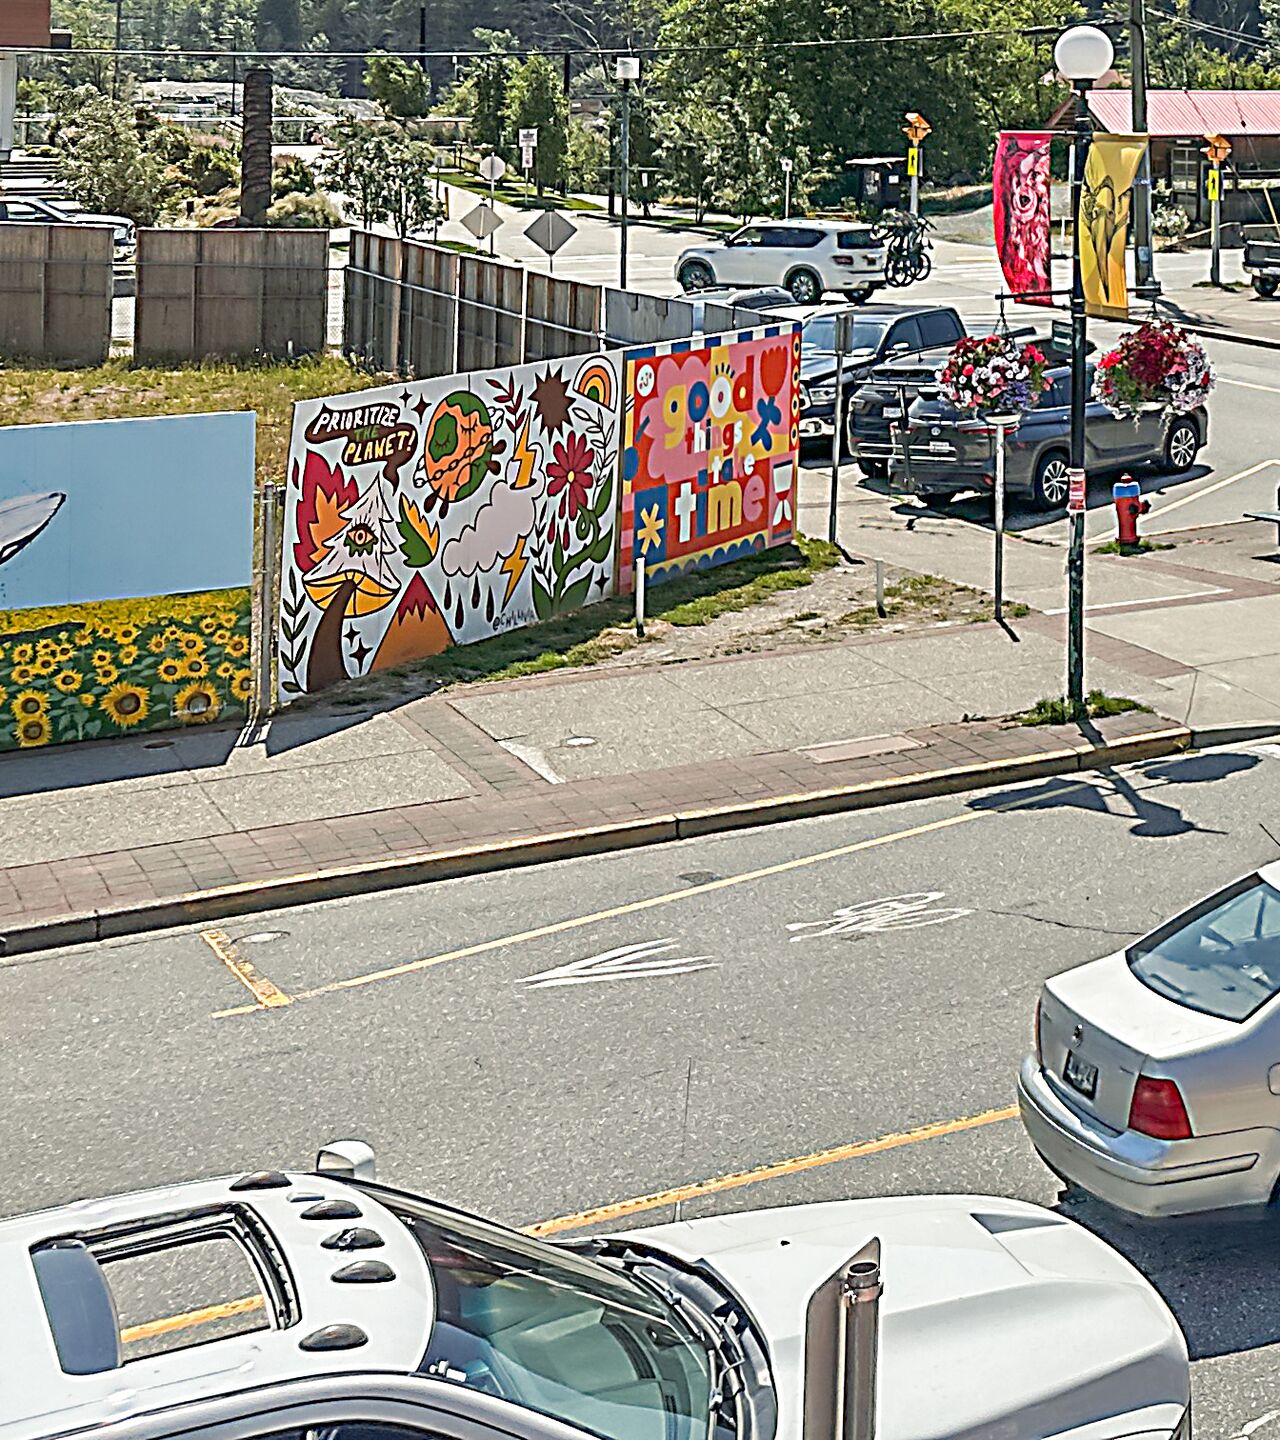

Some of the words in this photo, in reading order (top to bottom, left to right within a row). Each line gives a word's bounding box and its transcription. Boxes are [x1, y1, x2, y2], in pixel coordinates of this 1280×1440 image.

[313, 406, 399, 435] PRIORITIZE
[662, 355, 755, 449] good
[344, 430, 416, 464] PLANET!
[354, 425, 380, 442] THE
[685, 419, 743, 457] things
[711, 447, 756, 484] take
[675, 469, 766, 543] time
